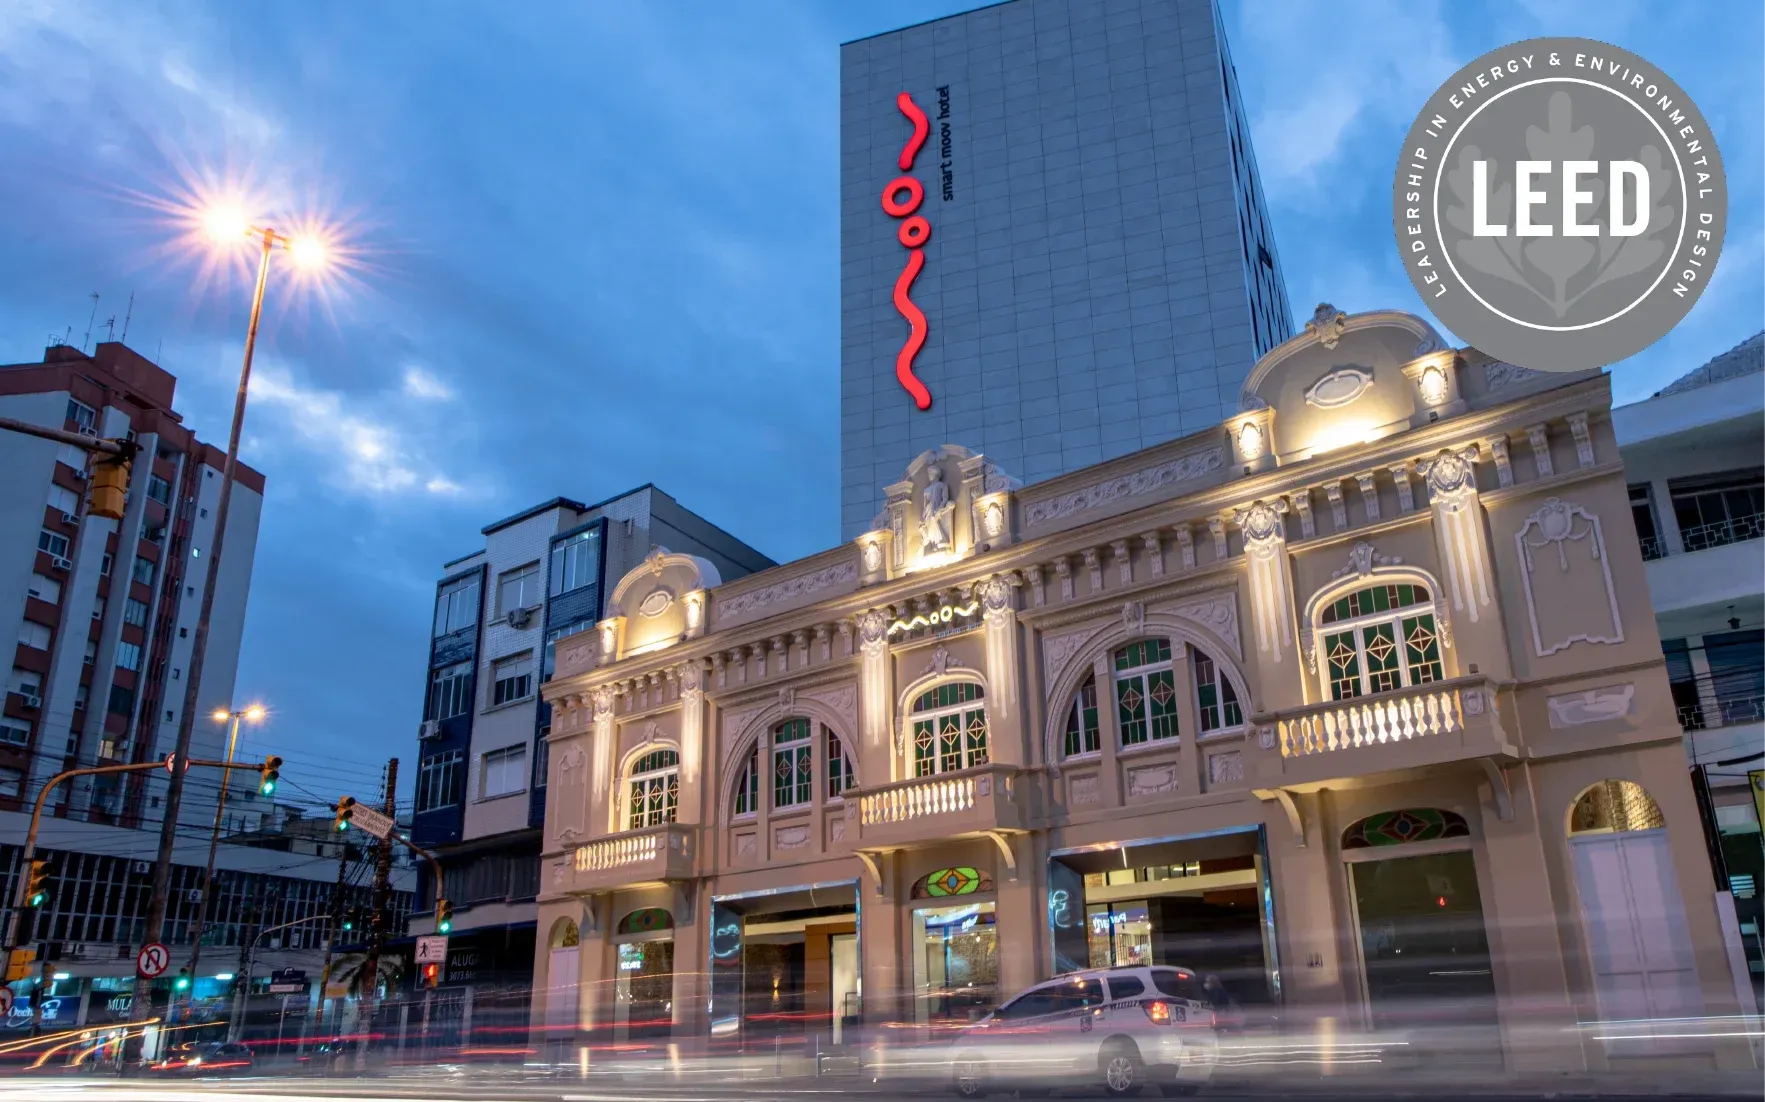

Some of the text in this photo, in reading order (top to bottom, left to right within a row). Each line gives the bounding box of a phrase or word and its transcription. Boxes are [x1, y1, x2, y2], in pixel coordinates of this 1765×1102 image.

[936, 84, 954, 202] smart moov hotel
